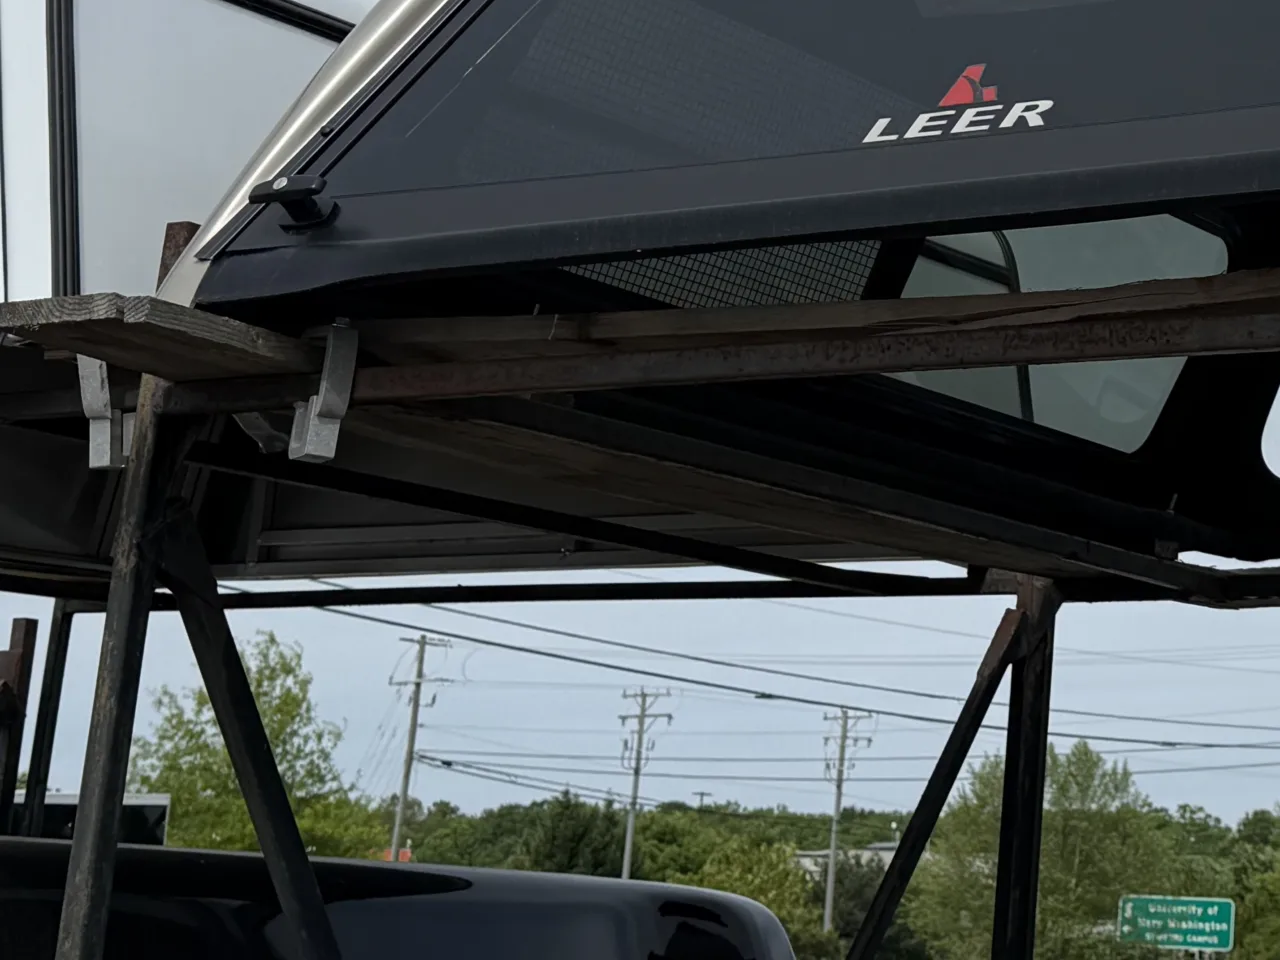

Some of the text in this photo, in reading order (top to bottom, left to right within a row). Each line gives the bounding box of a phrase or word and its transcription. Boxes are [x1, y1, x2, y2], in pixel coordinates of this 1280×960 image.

[862, 99, 1054, 143] LEER
[1207, 905, 1218, 916] of
[1167, 918, 1228, 932] Washington
